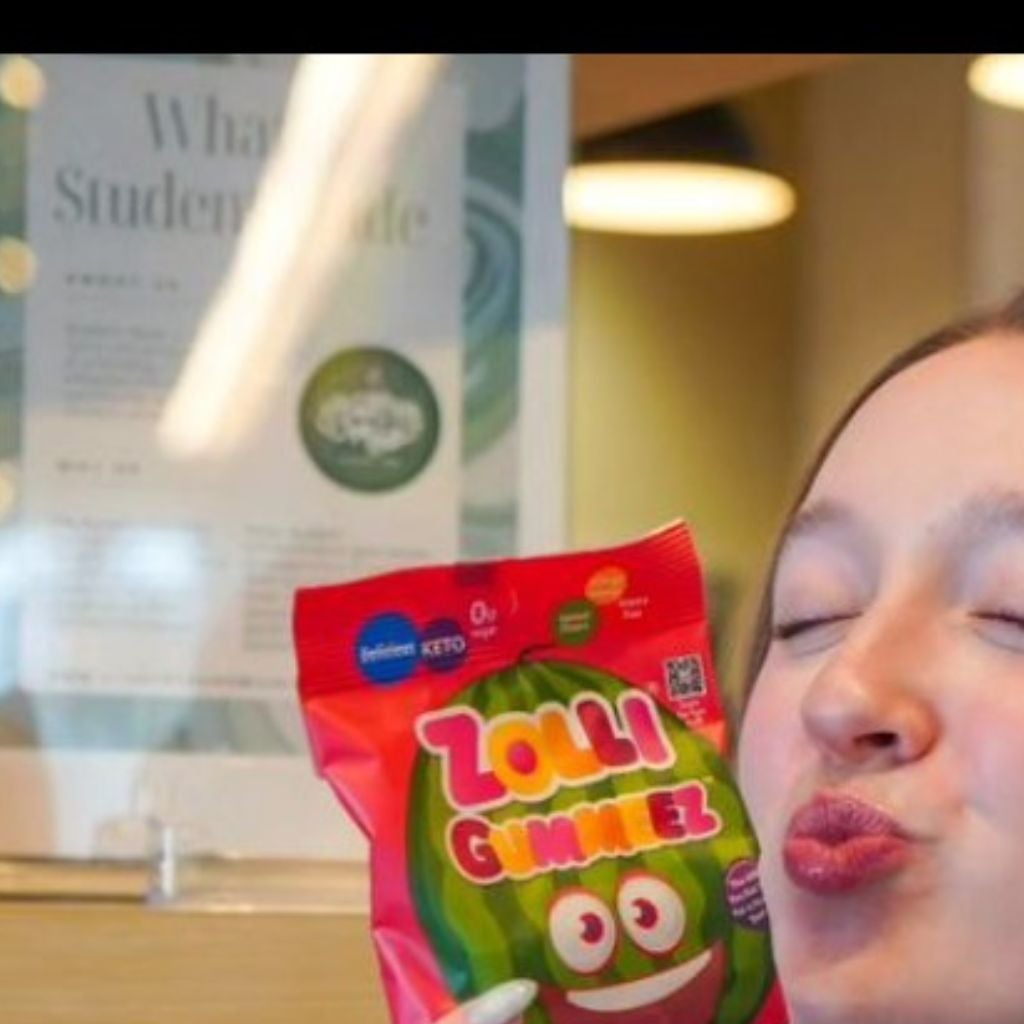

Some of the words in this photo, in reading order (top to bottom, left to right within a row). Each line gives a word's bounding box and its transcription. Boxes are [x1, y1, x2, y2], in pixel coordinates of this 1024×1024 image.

[142, 92, 281, 158] Wha
[52, 167, 246, 236] Studen
[421, 635, 466, 657] KETO
[416, 689, 677, 813] ZOLLI
